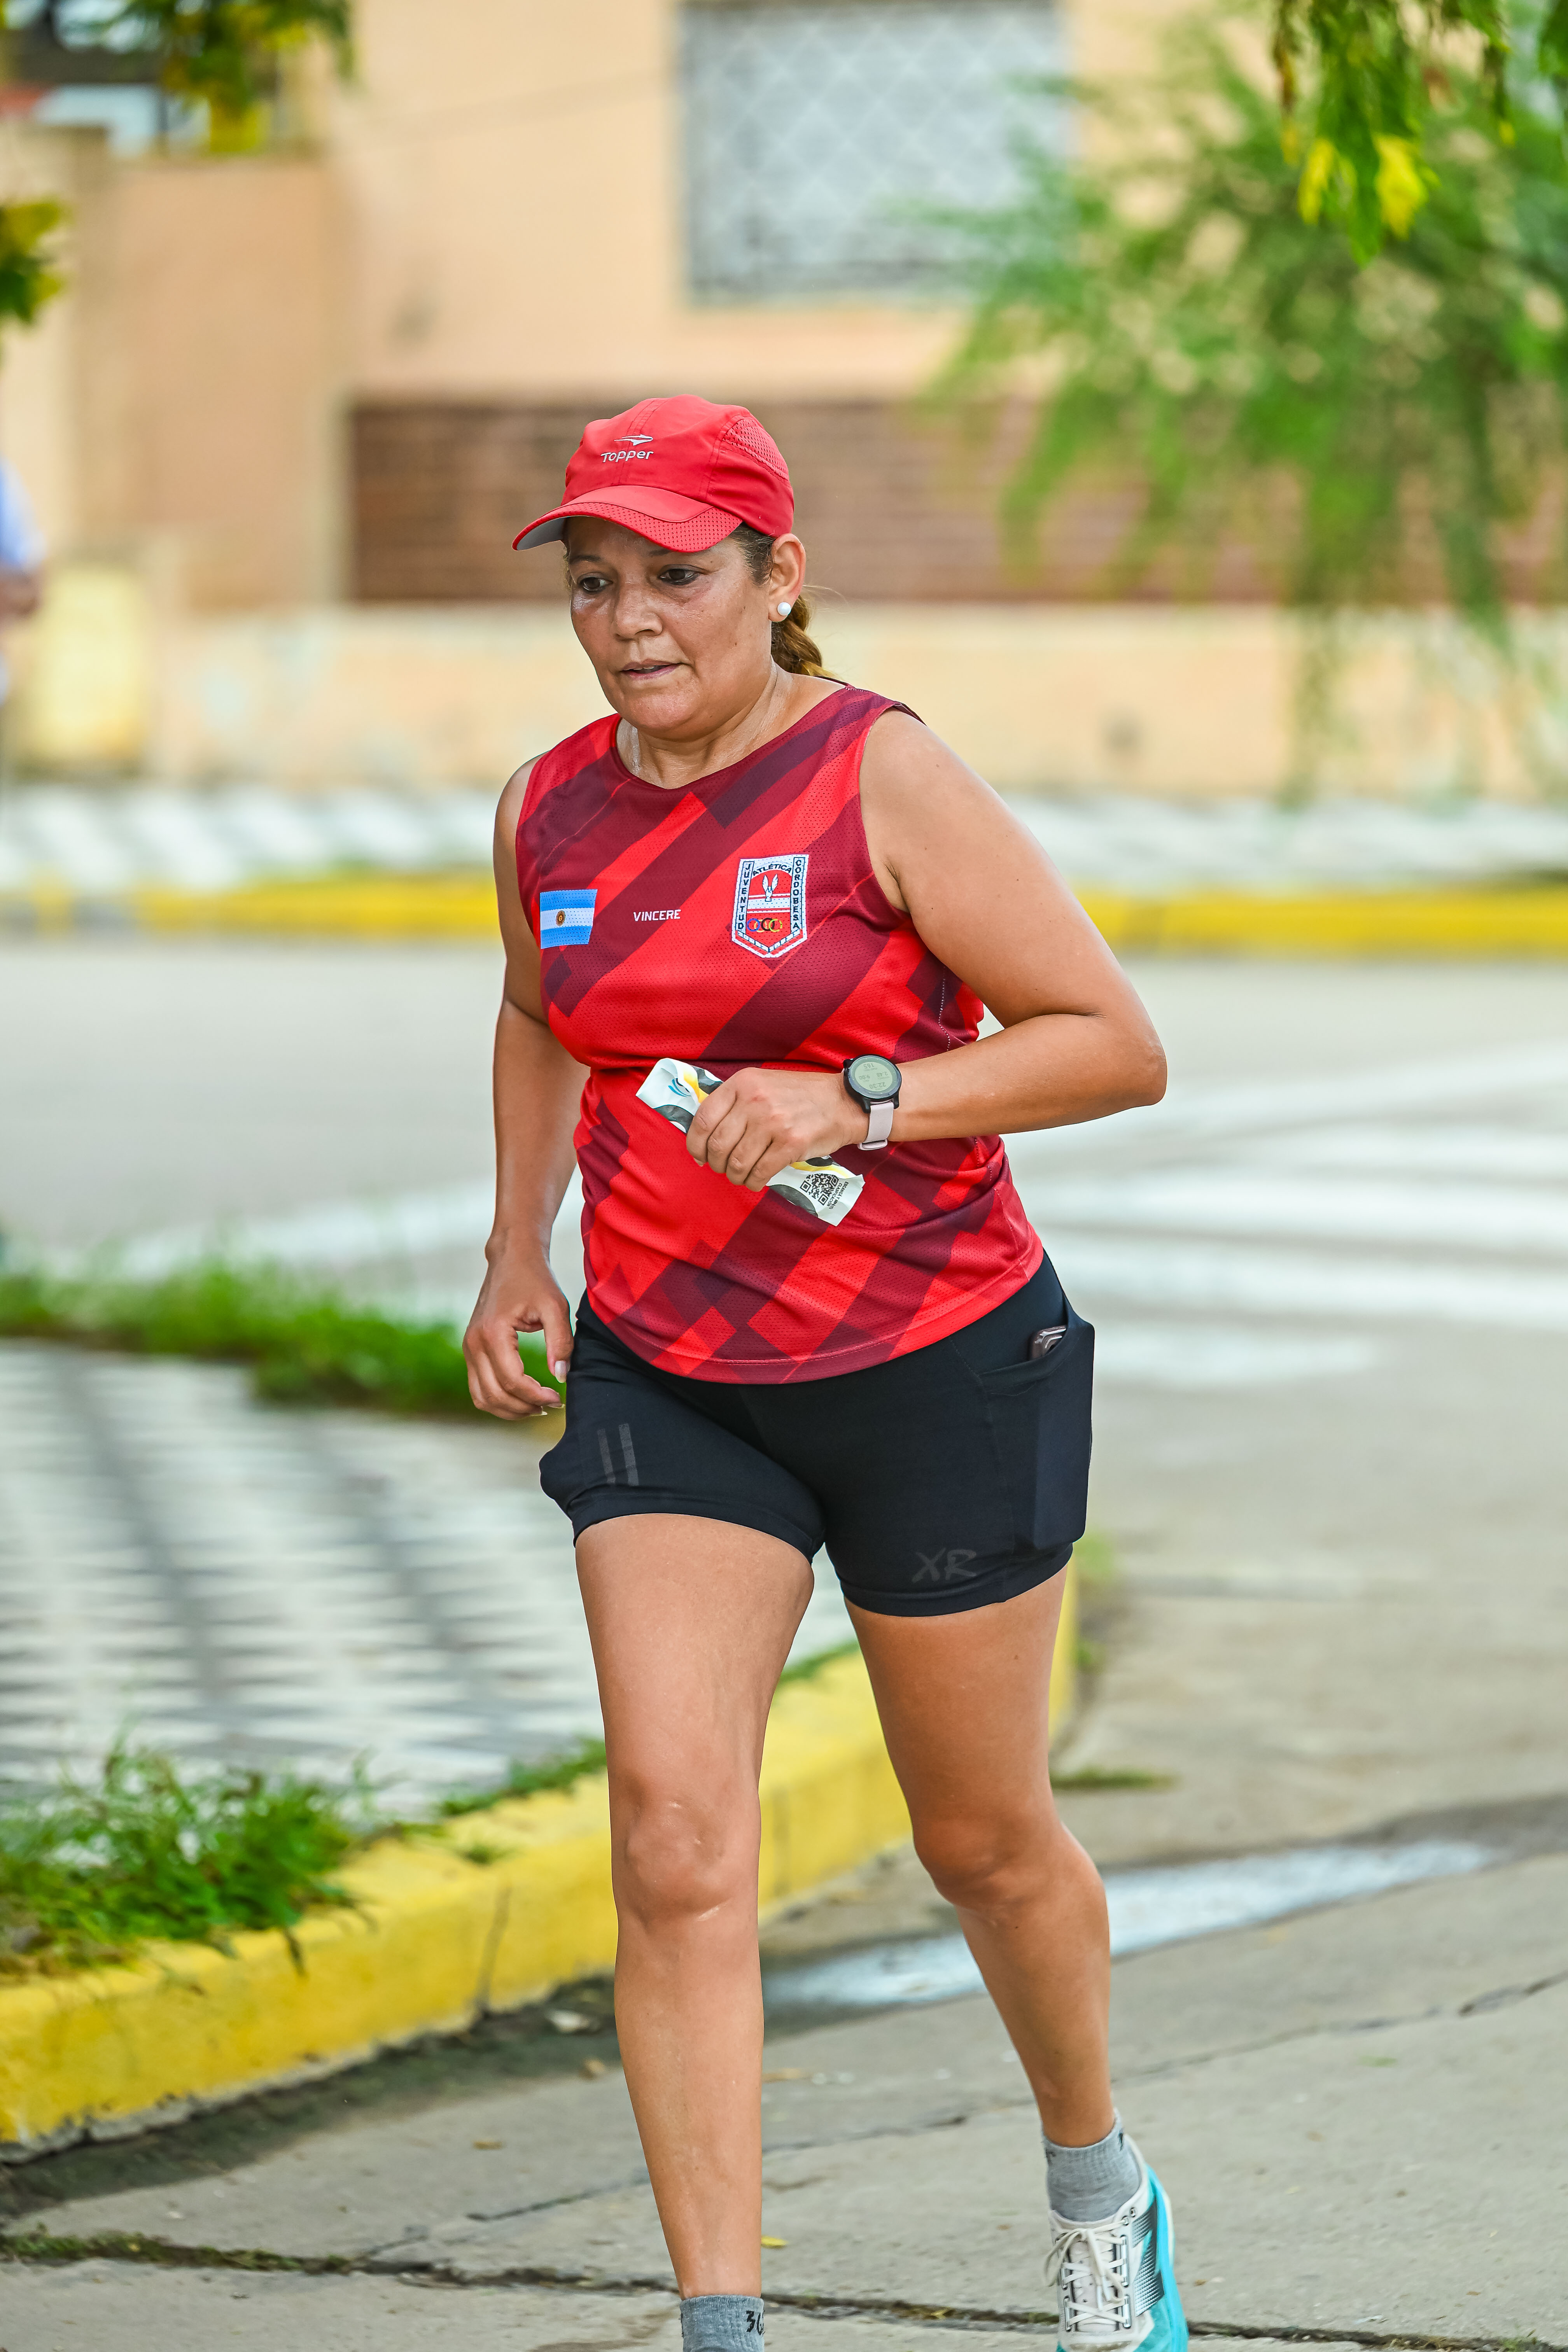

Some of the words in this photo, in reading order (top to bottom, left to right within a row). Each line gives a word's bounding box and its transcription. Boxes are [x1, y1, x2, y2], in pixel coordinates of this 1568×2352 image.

[600, 450, 654, 462] Topper
[753, 863, 792, 876] ATLÉTICA
[738, 863, 751, 929] JUVENTUD
[793, 860, 802, 929] CORDOBESA
[633, 909, 681, 921] VINCERE
[912, 1547, 977, 1583] XR
